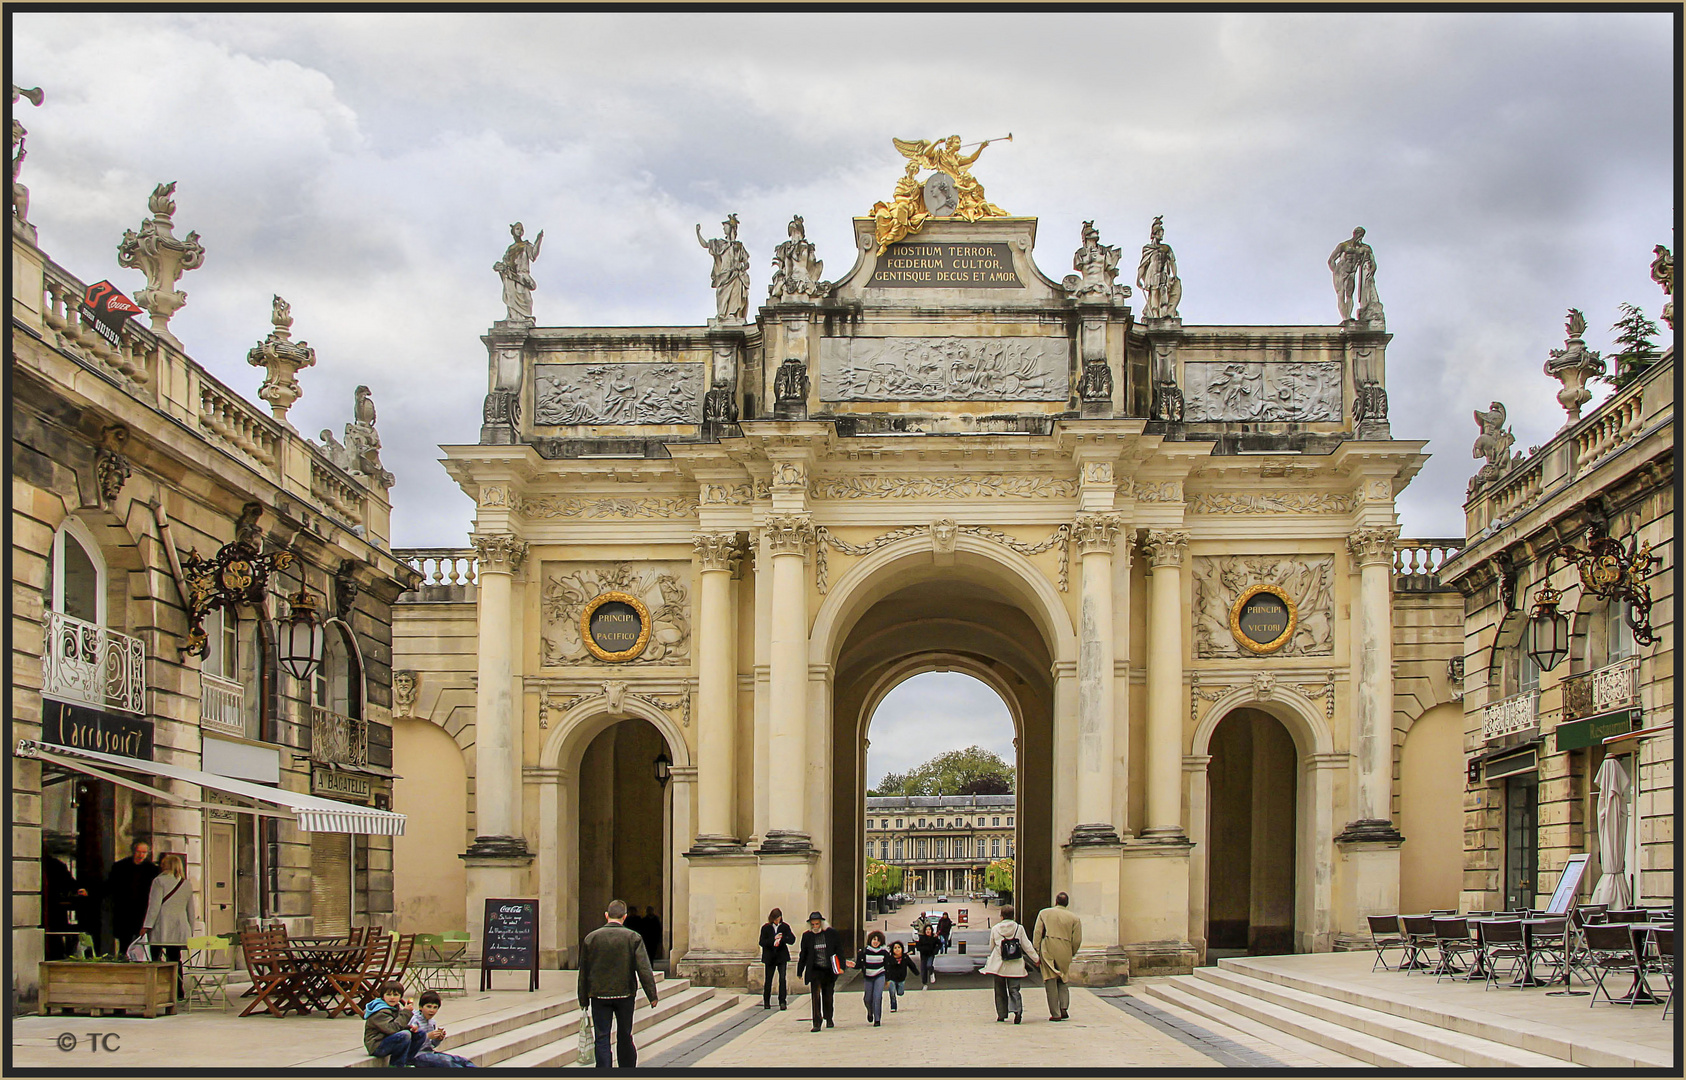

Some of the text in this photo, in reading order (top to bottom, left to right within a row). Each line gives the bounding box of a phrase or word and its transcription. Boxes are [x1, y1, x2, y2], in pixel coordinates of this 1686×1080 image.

[893, 246, 996, 257] HOSTIUM TERROR.
[887, 259, 1003, 270] FŒDERUM CULTOR.
[874, 271, 1016, 282] GENTISQUE DECUS ET AMOR
[1247, 606, 1281, 614] PRINCIPI
[598, 614, 634, 622] PRINCIPI
[1248, 624, 1280, 632] VICTORI
[596, 632, 635, 640] PACIFICO
[318, 773, 367, 794] A BAGATELLE
